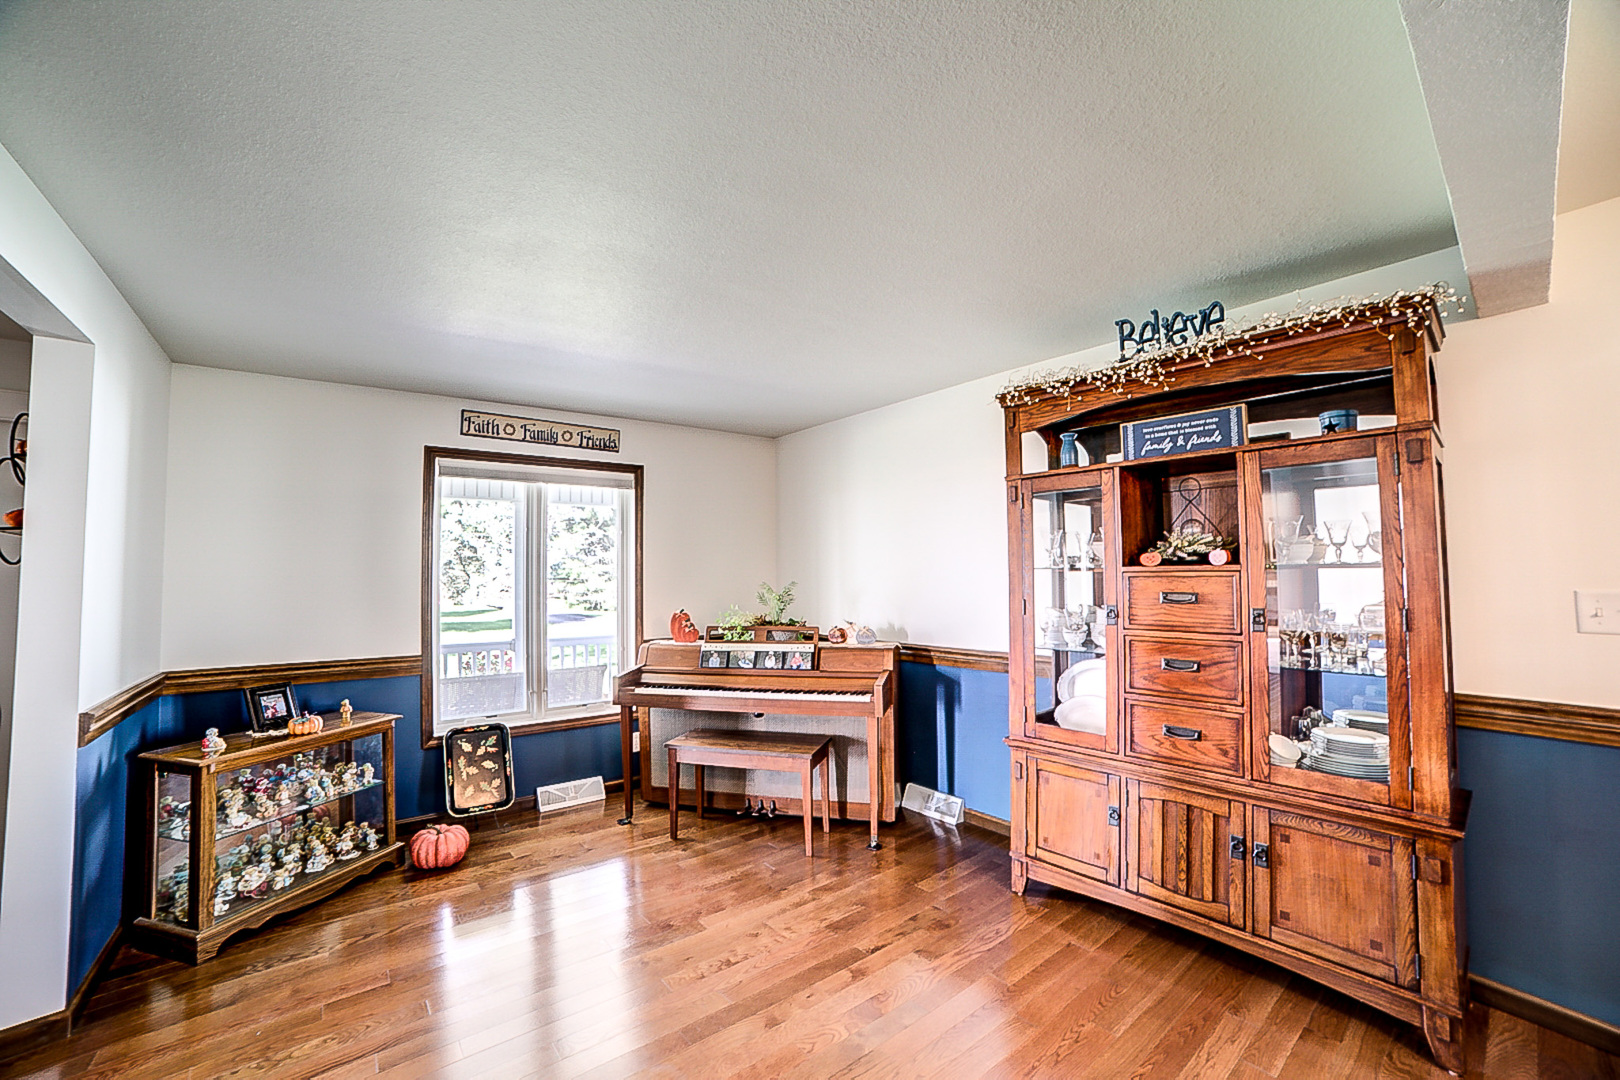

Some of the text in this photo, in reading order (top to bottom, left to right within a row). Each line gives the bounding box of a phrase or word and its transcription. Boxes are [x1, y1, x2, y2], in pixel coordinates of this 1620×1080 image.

[1115, 300, 1225, 361] Believe
[464, 415, 500, 436] Faith
[520, 423, 559, 444] Family
[1140, 430, 1222, 456] family & friends
